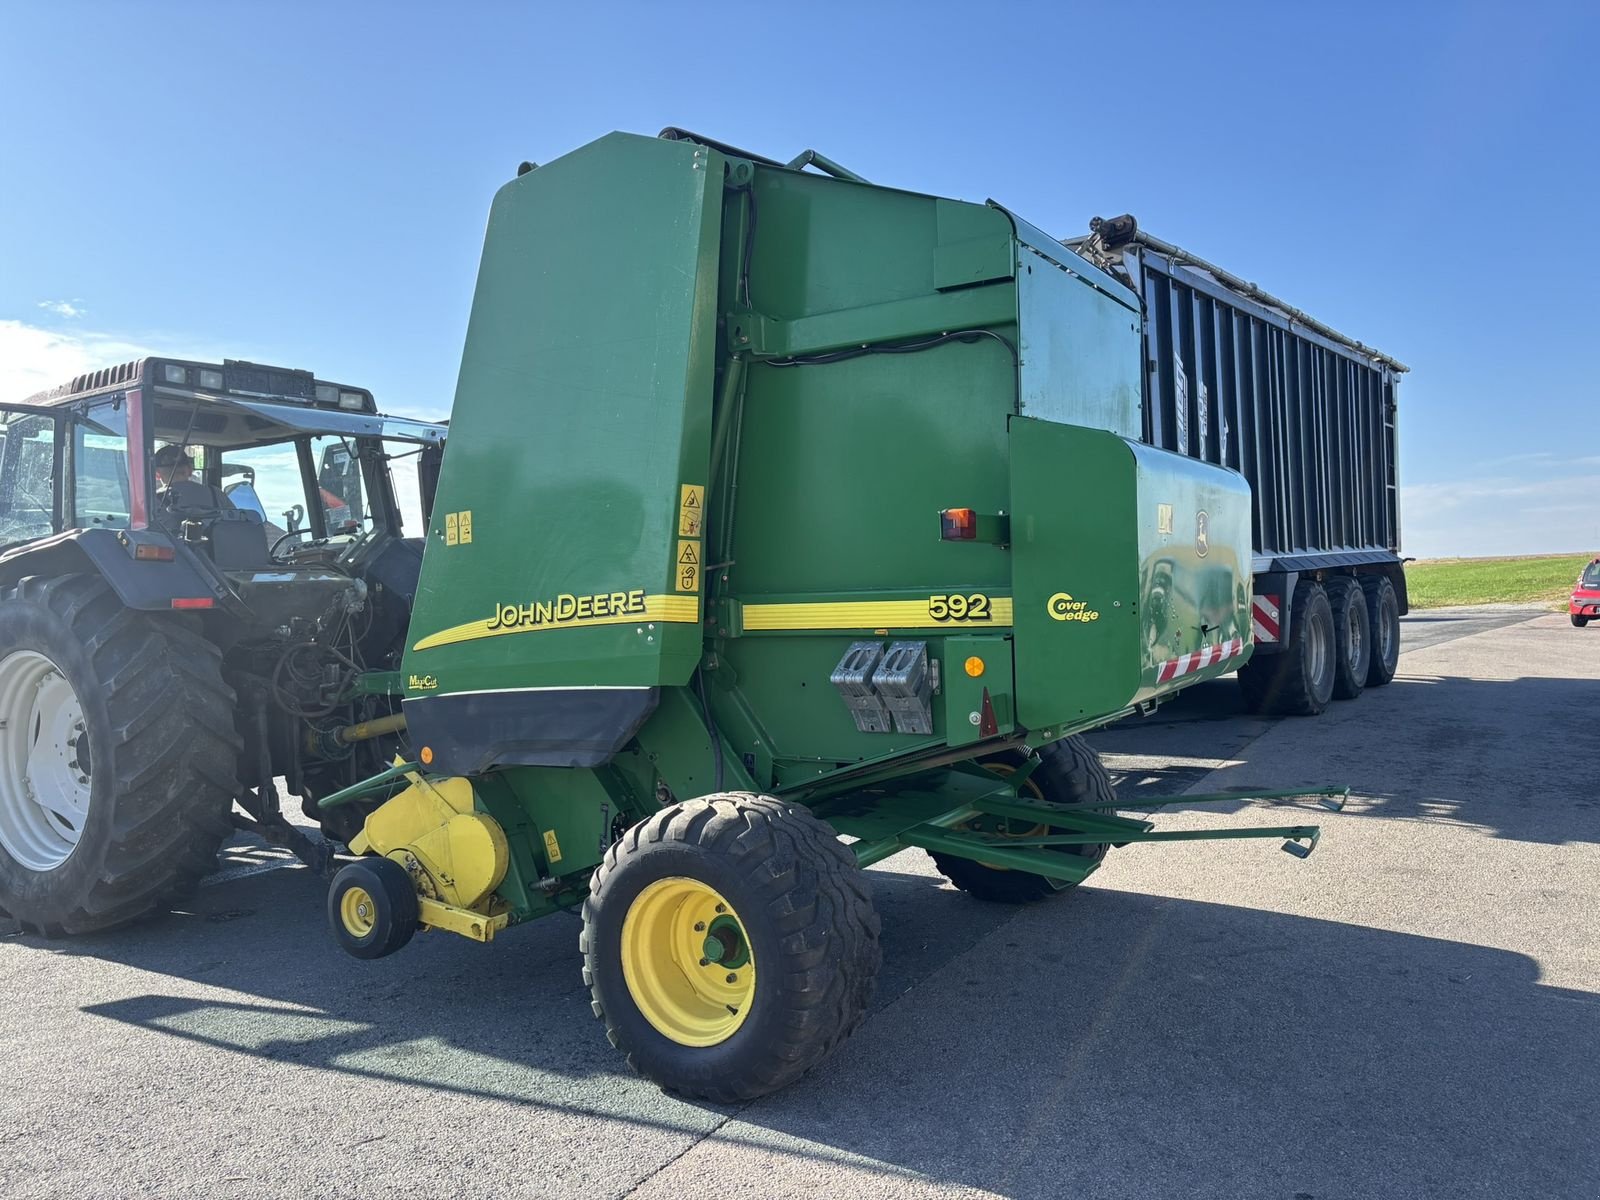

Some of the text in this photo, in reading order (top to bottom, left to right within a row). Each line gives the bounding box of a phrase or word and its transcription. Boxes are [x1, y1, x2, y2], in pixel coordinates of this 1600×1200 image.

[487, 589, 646, 629] JOHN DEERE
[929, 593, 989, 620] 592
[1047, 592, 1087, 621] Cover
[1065, 609, 1099, 623] edge
